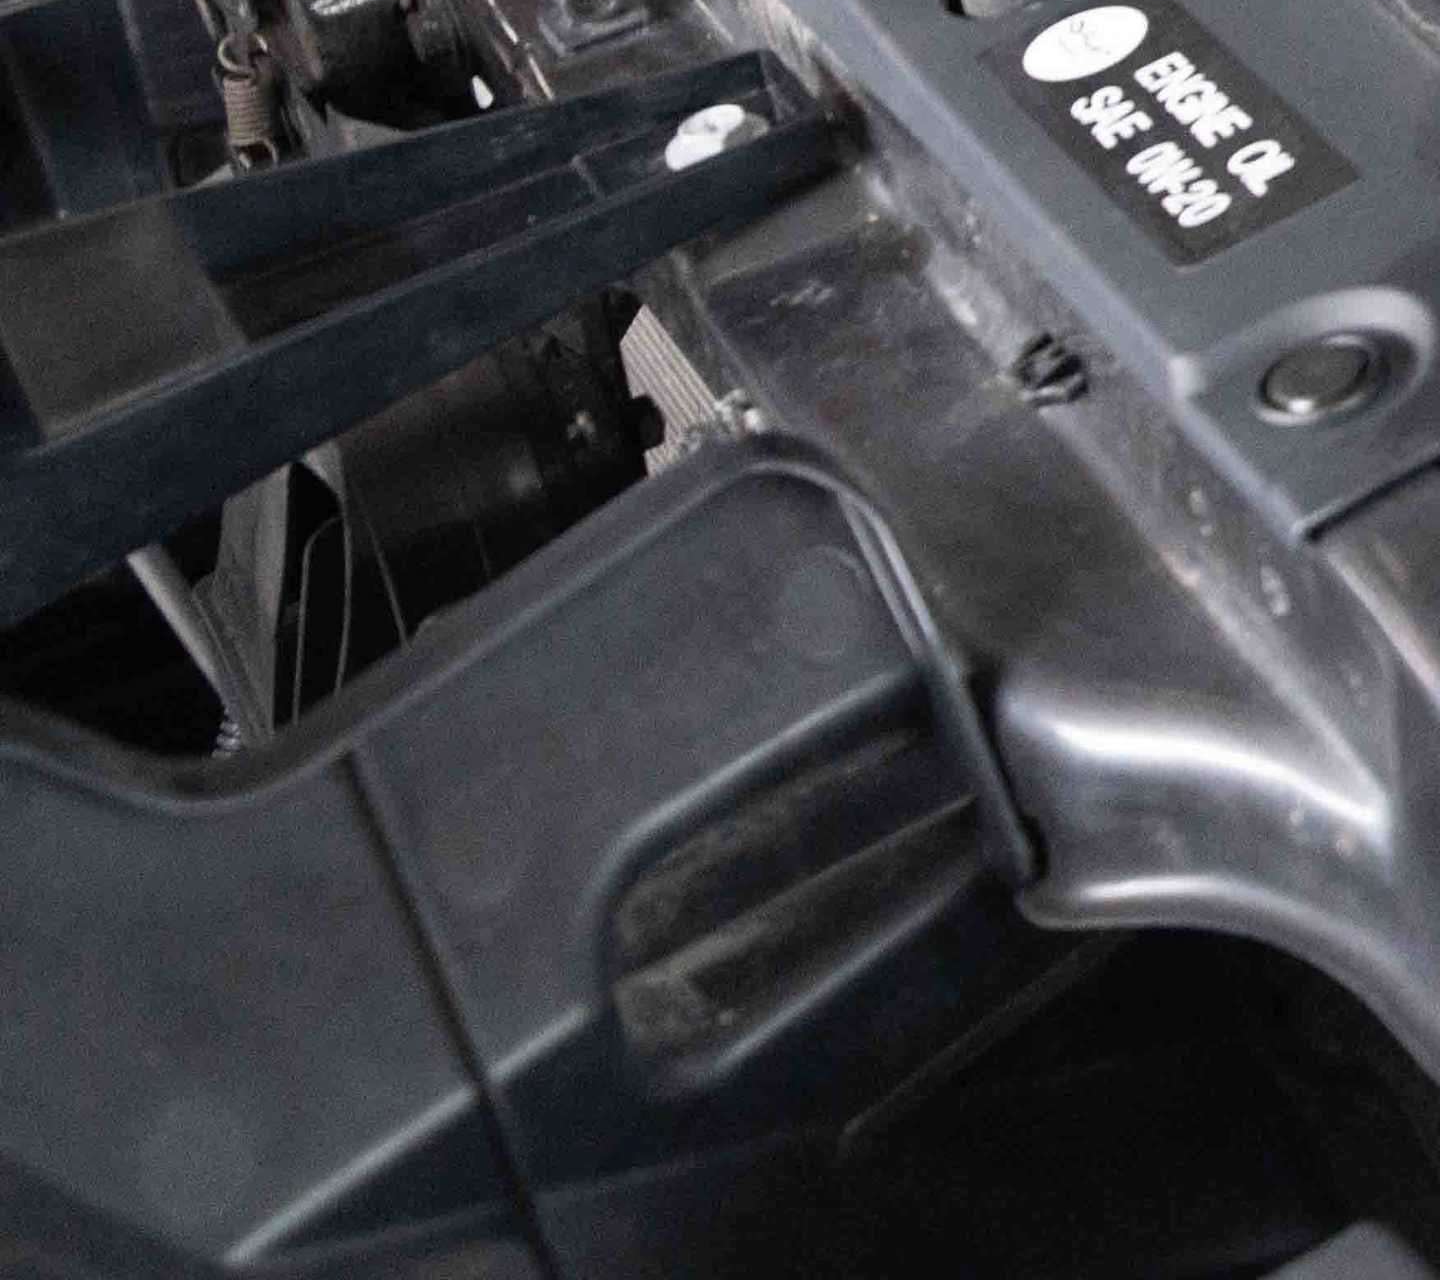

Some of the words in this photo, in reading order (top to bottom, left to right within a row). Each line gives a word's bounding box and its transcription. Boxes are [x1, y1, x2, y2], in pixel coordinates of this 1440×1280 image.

[1069, 85, 1154, 150] SAE
[1133, 51, 1254, 148] ENGINE
[1226, 138, 1296, 198] OIL
